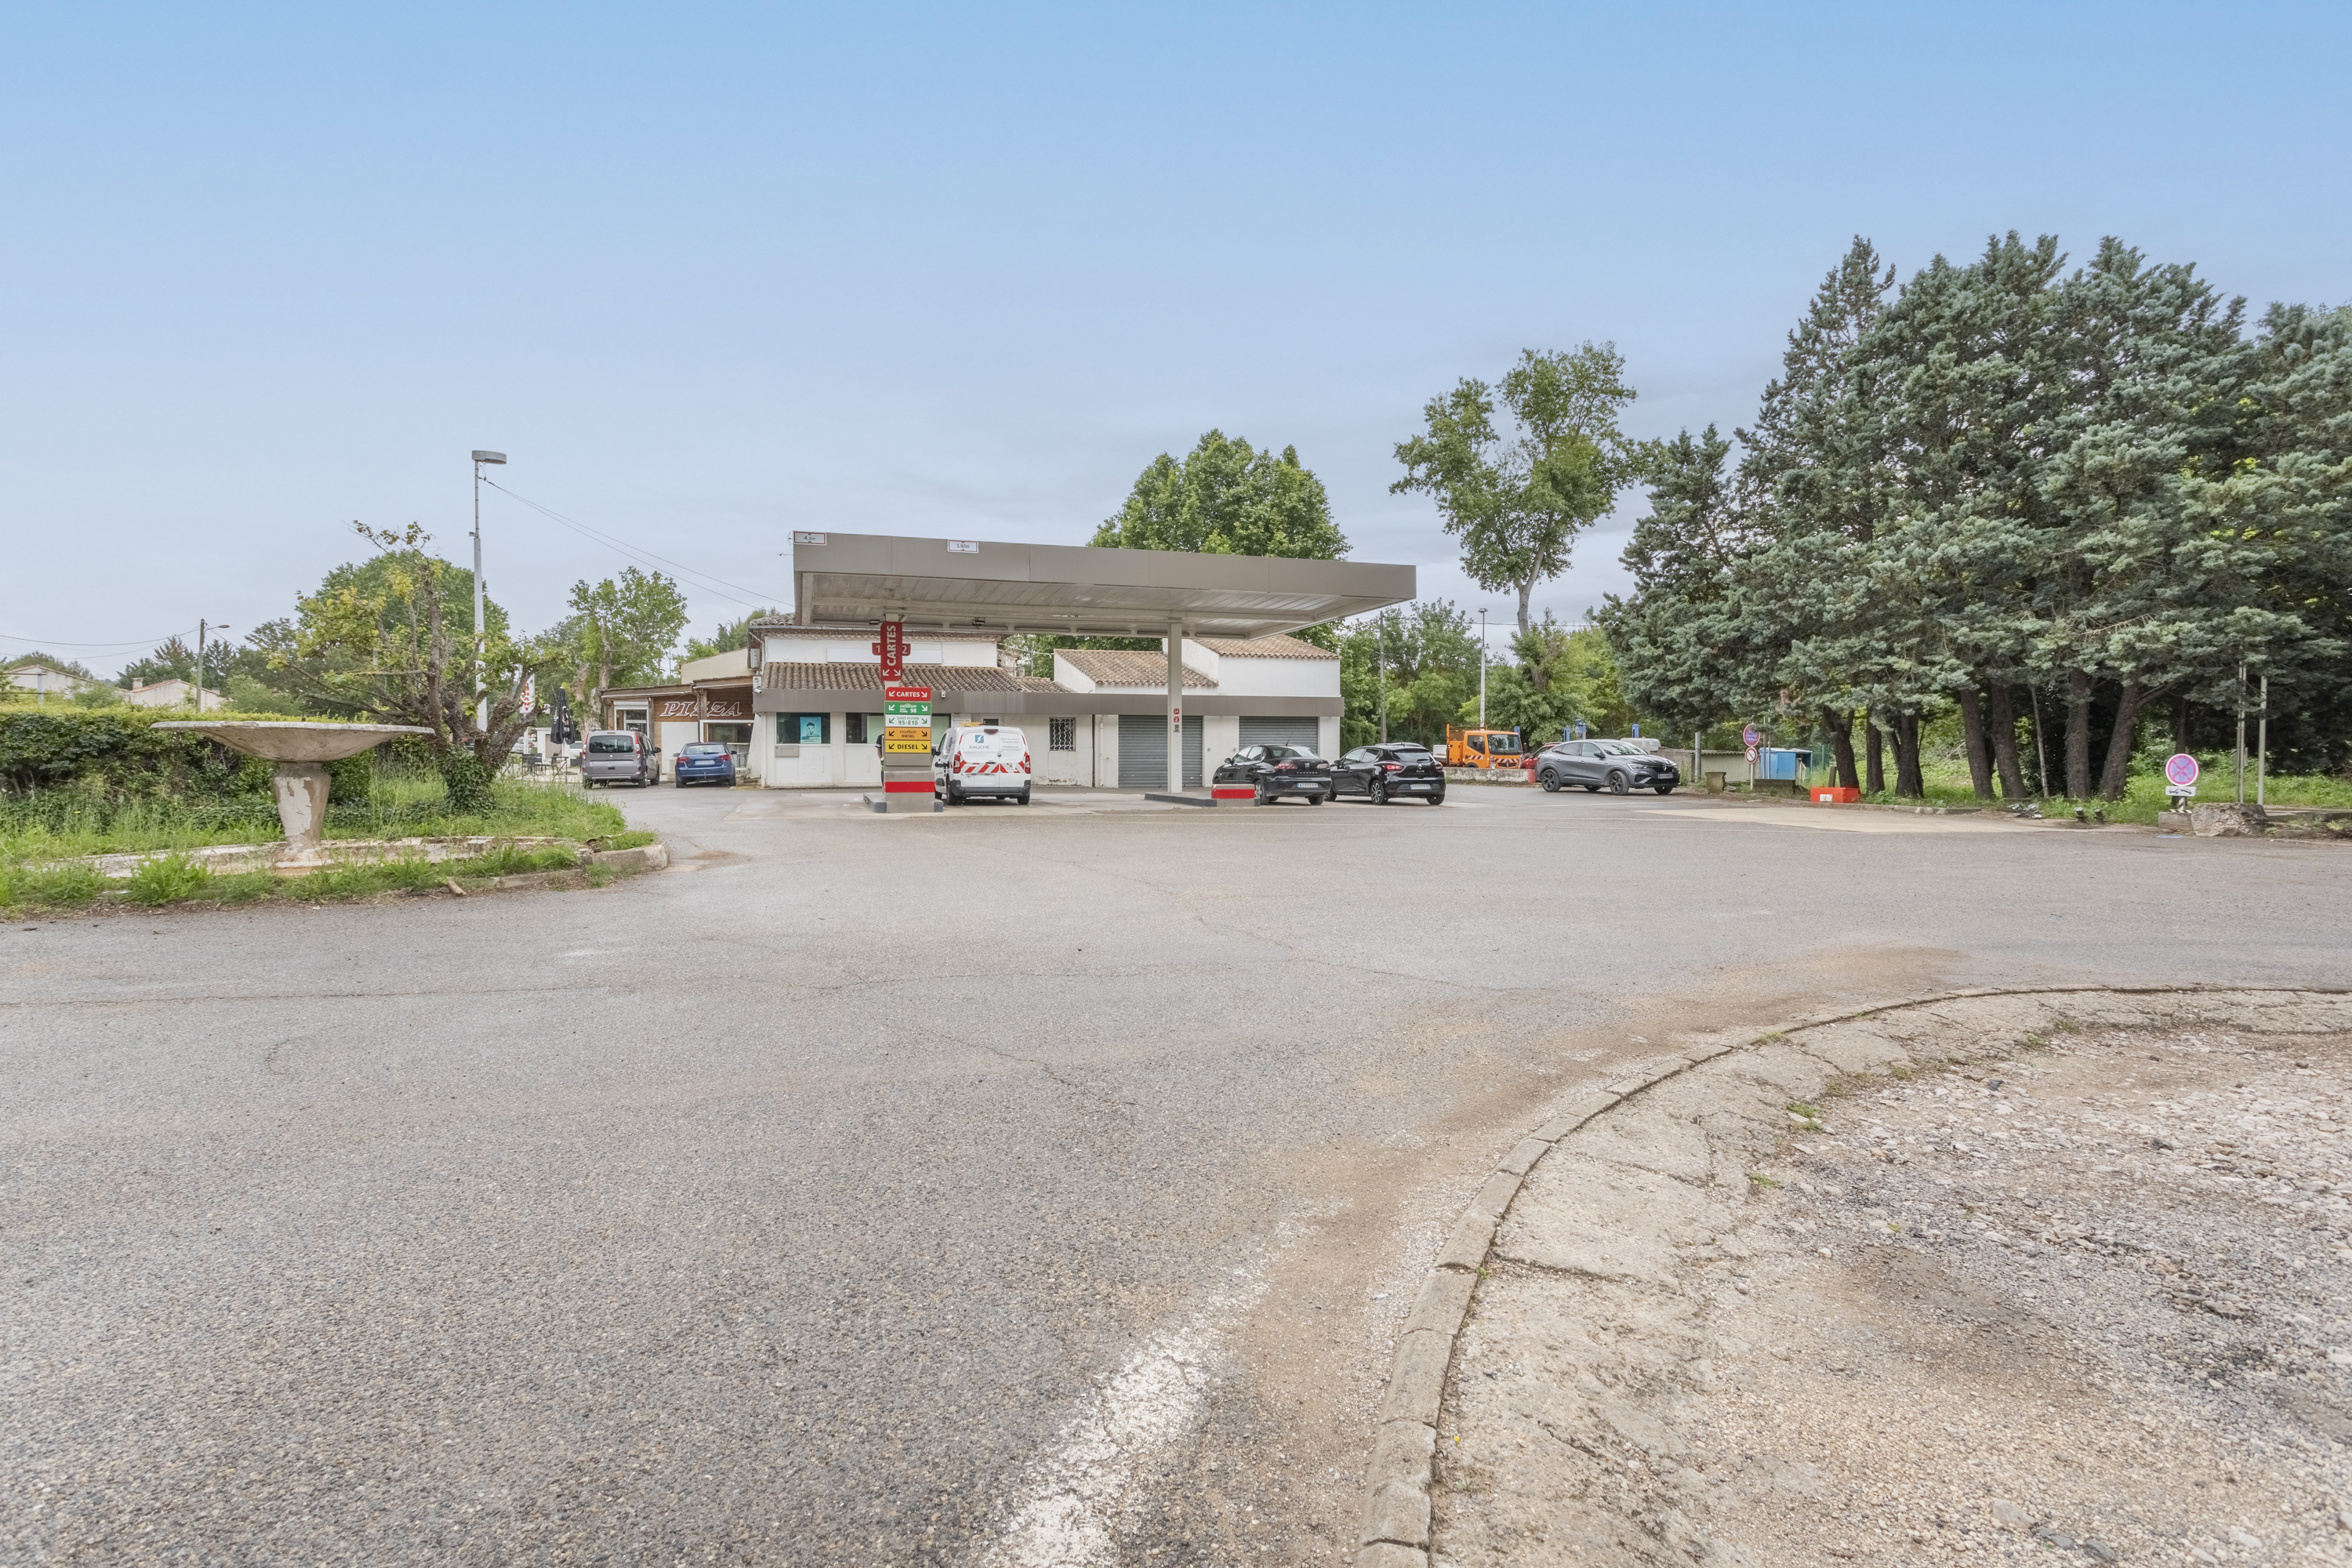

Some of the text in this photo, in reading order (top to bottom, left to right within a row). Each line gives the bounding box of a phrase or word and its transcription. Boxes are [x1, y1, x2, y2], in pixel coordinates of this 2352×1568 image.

[876, 644, 880, 654] 1
[887, 625, 896, 666] CARTES
[902, 645, 908, 655] 2
